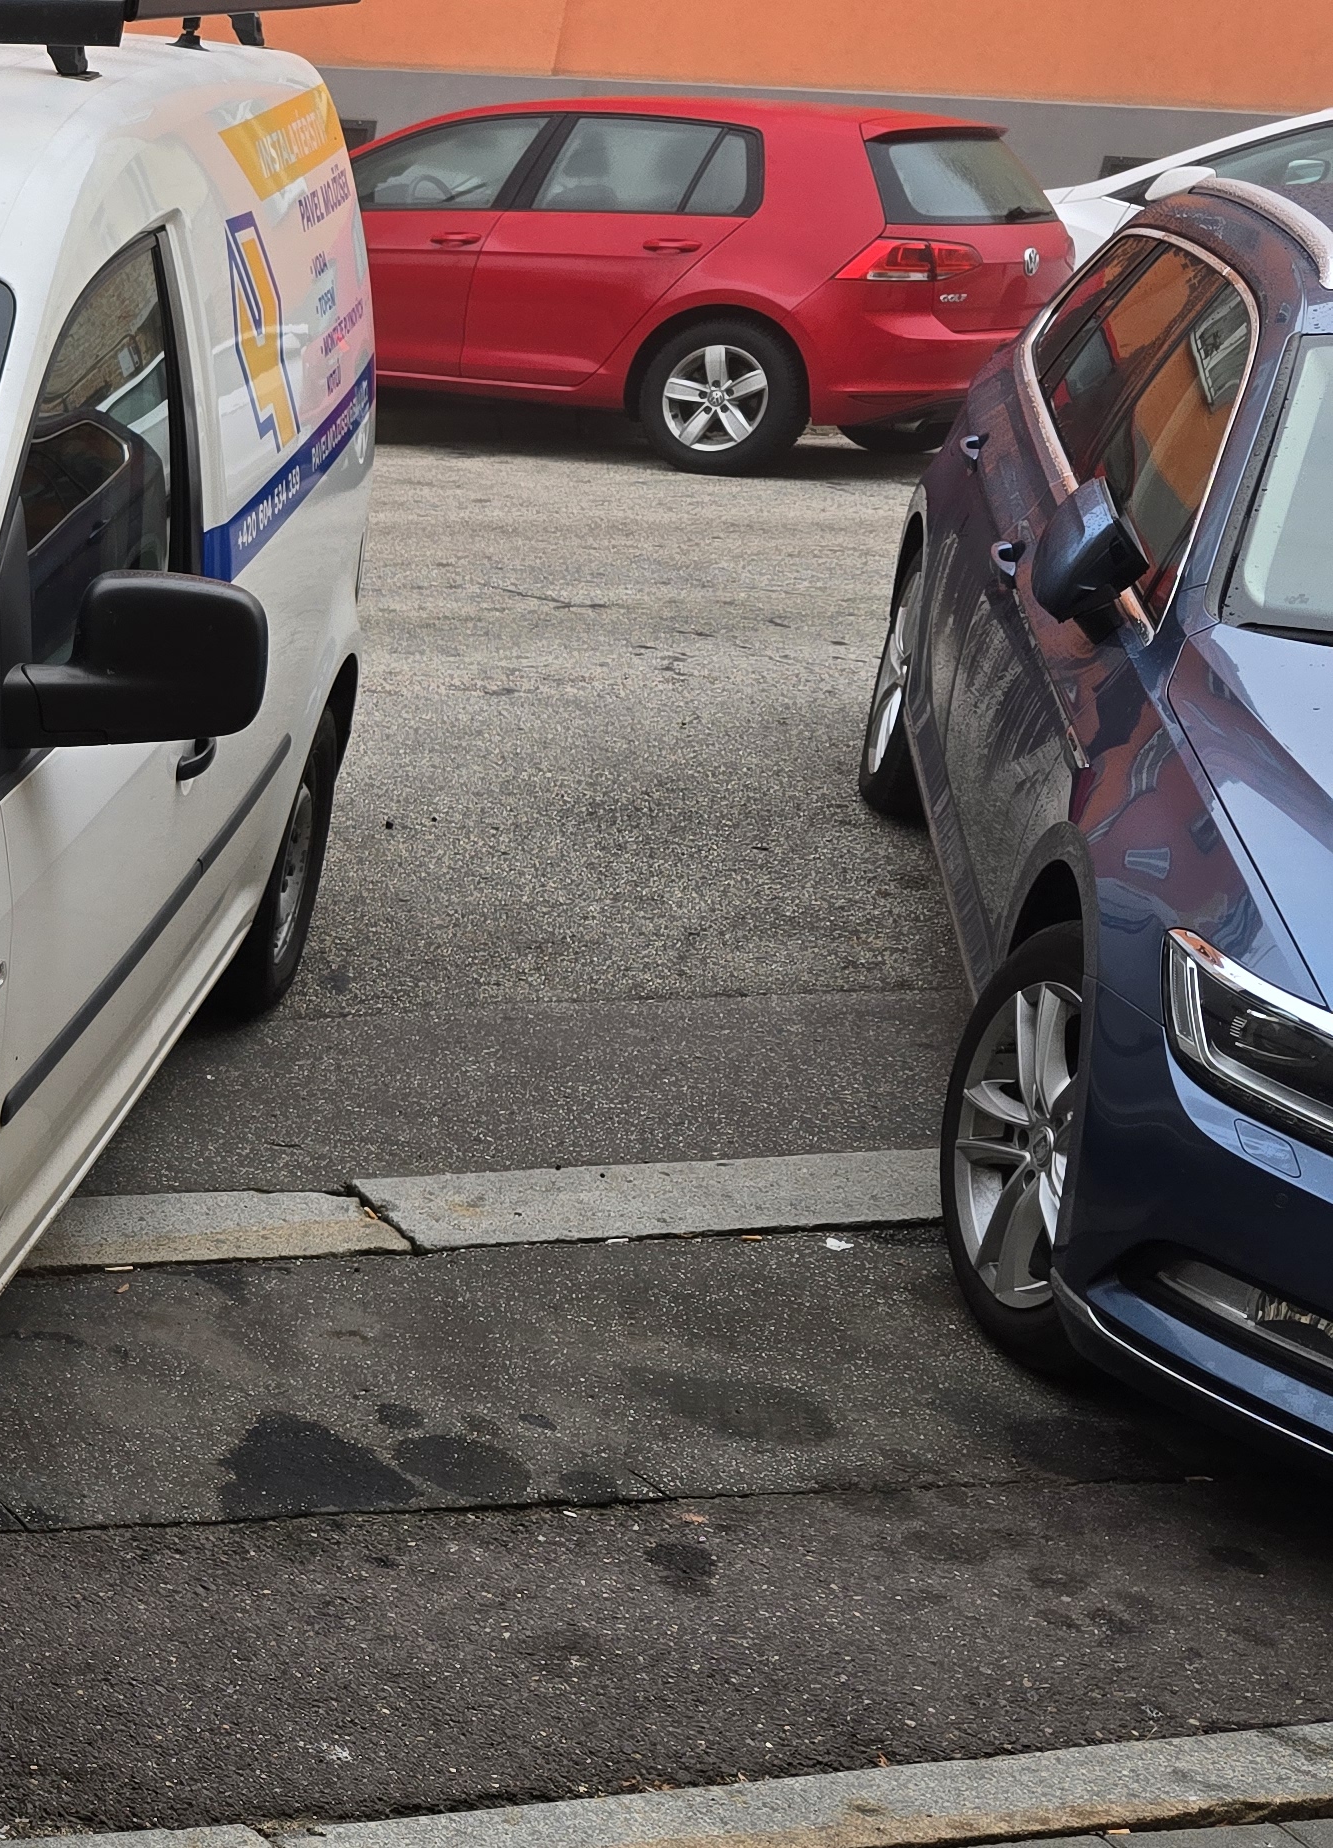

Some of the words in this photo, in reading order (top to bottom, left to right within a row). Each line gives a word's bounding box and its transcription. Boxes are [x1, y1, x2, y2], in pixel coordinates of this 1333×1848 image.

[298, 189, 325, 232] PAVEL
[312, 251, 328, 278] VODA
[939, 293, 968, 302] GOLF
[238, 511, 257, 550] +420
[259, 495, 272, 531] 604
[274, 479, 287, 515] 534
[288, 465, 300, 499] 359
